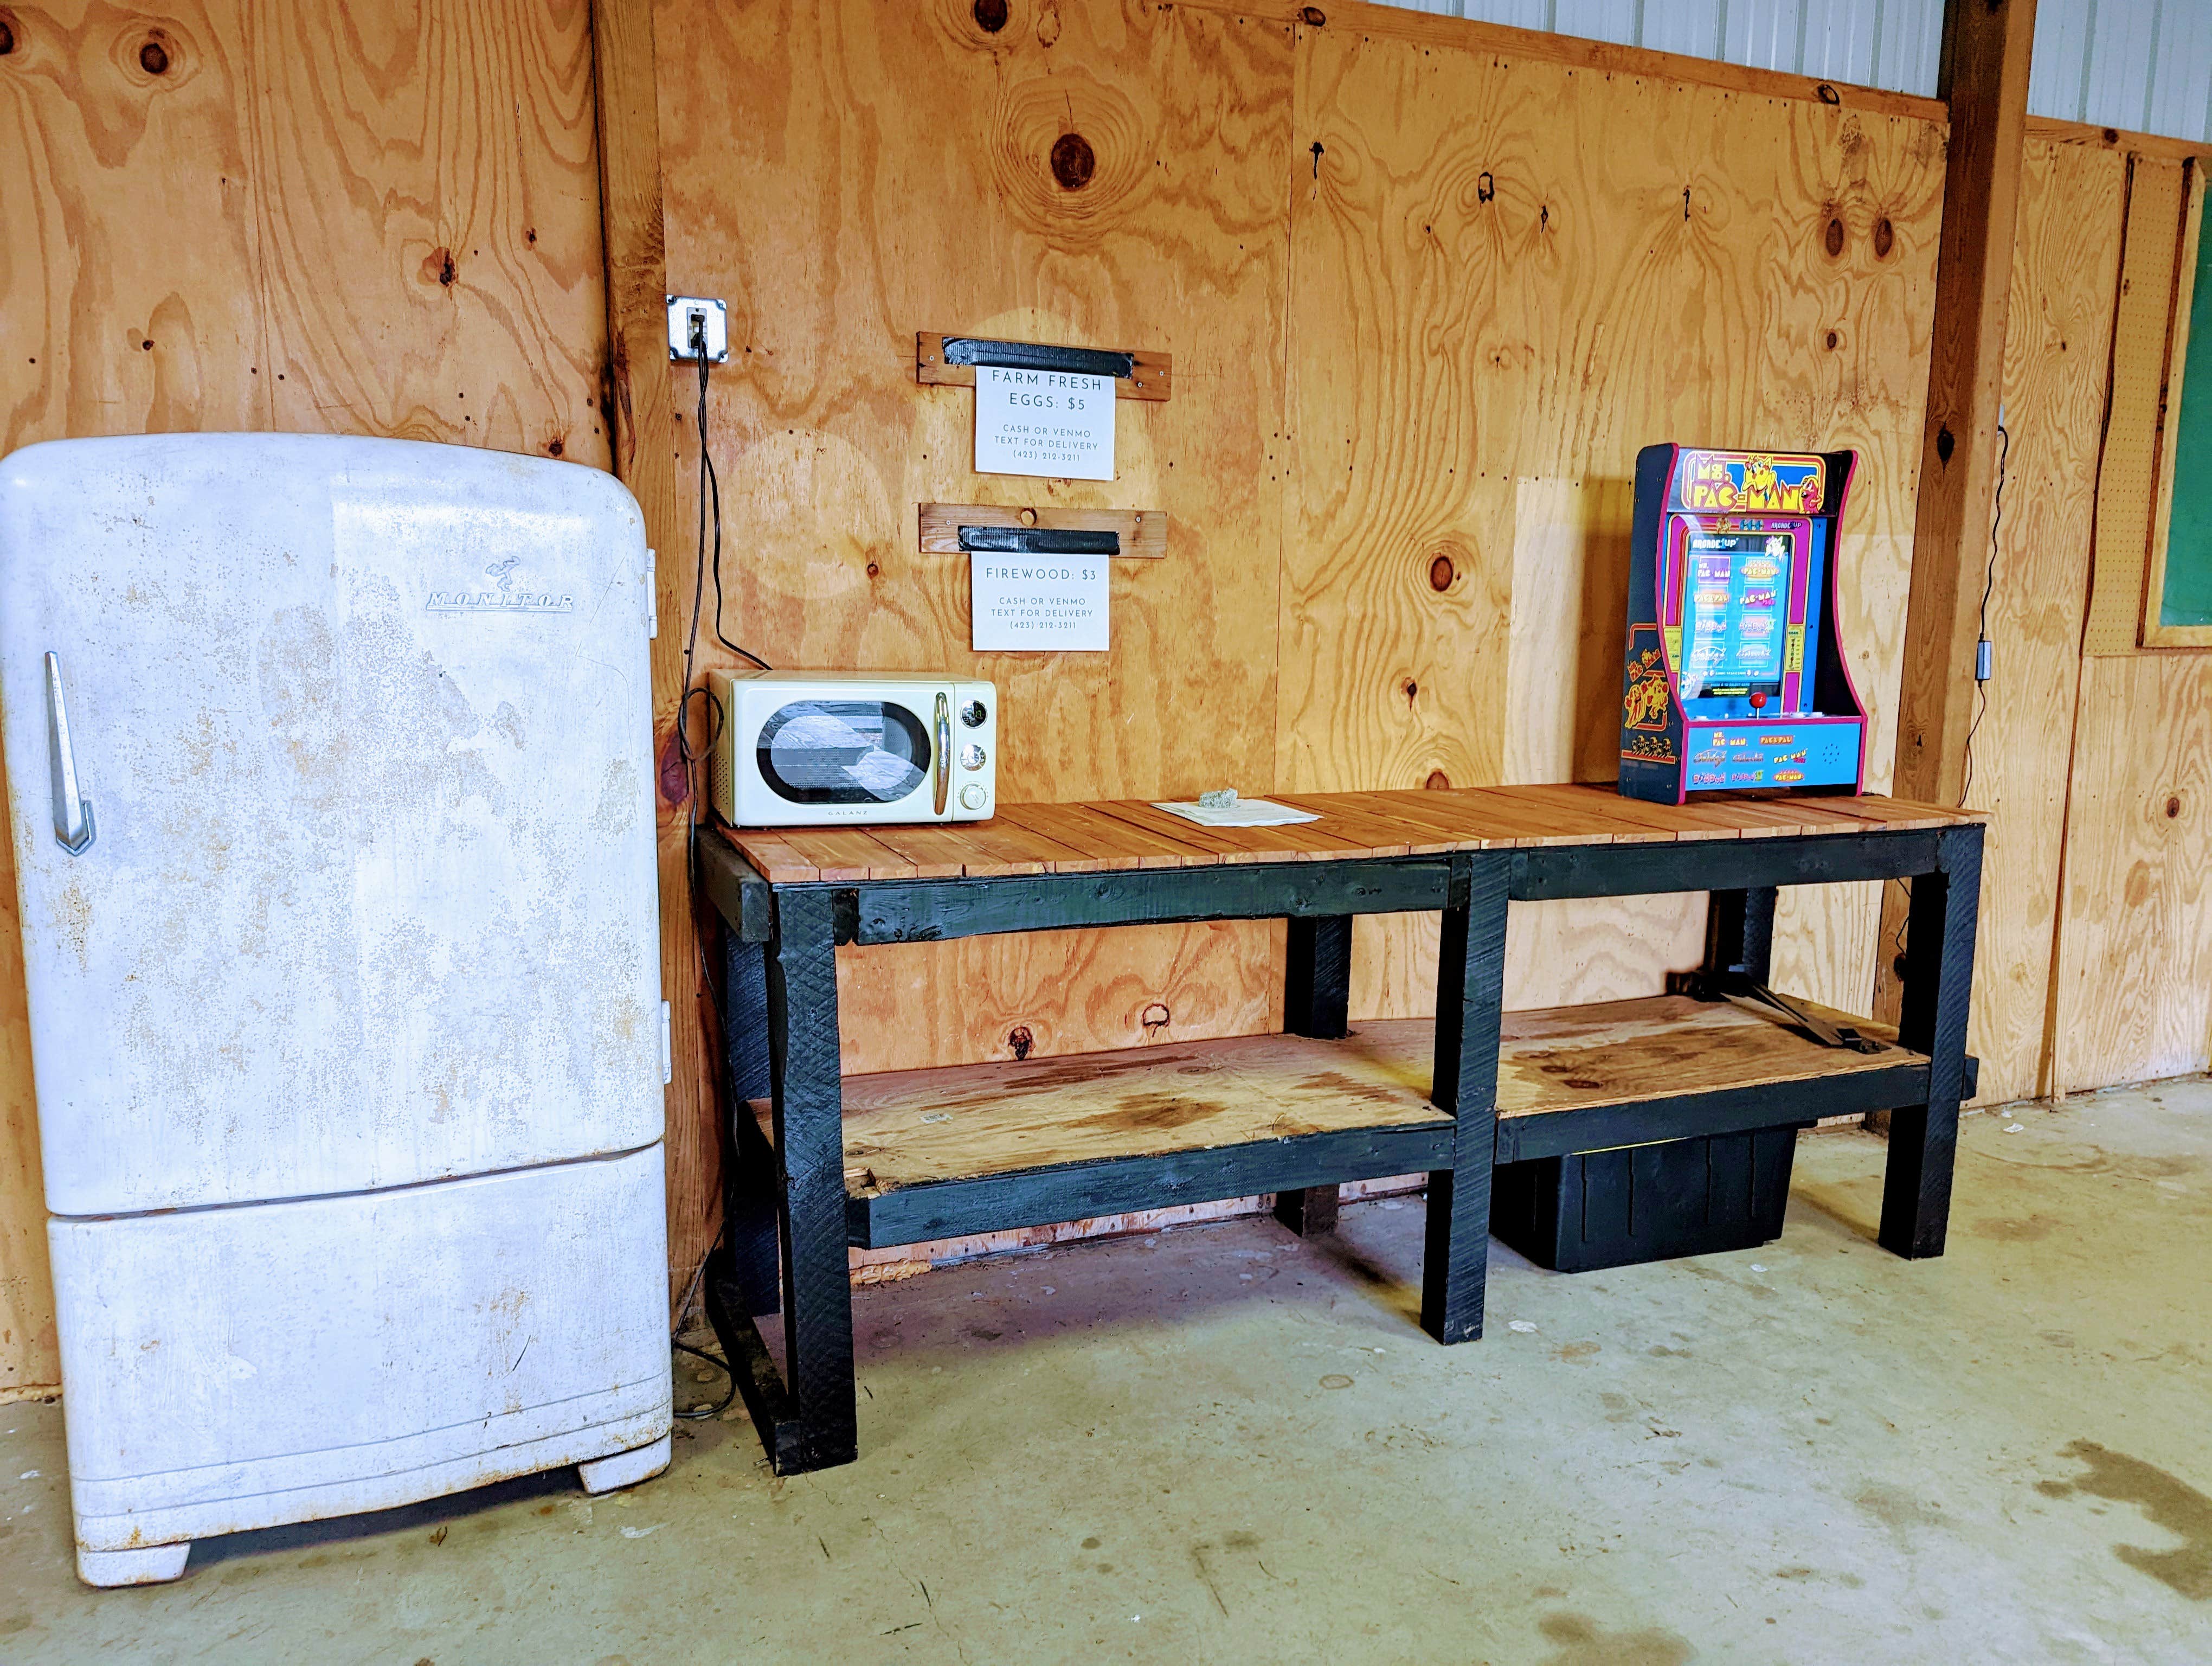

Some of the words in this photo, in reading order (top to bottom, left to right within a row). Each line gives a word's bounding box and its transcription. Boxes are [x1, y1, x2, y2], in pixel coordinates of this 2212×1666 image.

[993, 370, 1038, 386] FARM
[1049, 375, 1101, 390] FRESH
[1010, 393, 1058, 408] EGGS:
[1068, 397, 1084, 410] $5
[1004, 424, 1028, 434] CASH
[1034, 427, 1047, 435] OR
[1053, 428, 1090, 438] VENMO
[995, 435, 1019, 445] TEXT
[1024, 438, 1043, 447] FOR
[1049, 440, 1097, 450] DELIVERY
[1013, 450, 1037, 460] (423)
[1043, 452, 1079, 462] 212-3211
[1692, 483, 1799, 511] PAC-MAN
[987, 568, 1073, 580] FIREWOOD:
[1082, 568, 1095, 580] $3
[428, 592, 574, 608] MONITOR
[1000, 597, 1025, 605] CASH
[1045, 609, 1092, 617] DELIVERY
[1011, 621, 1034, 629] (423)
